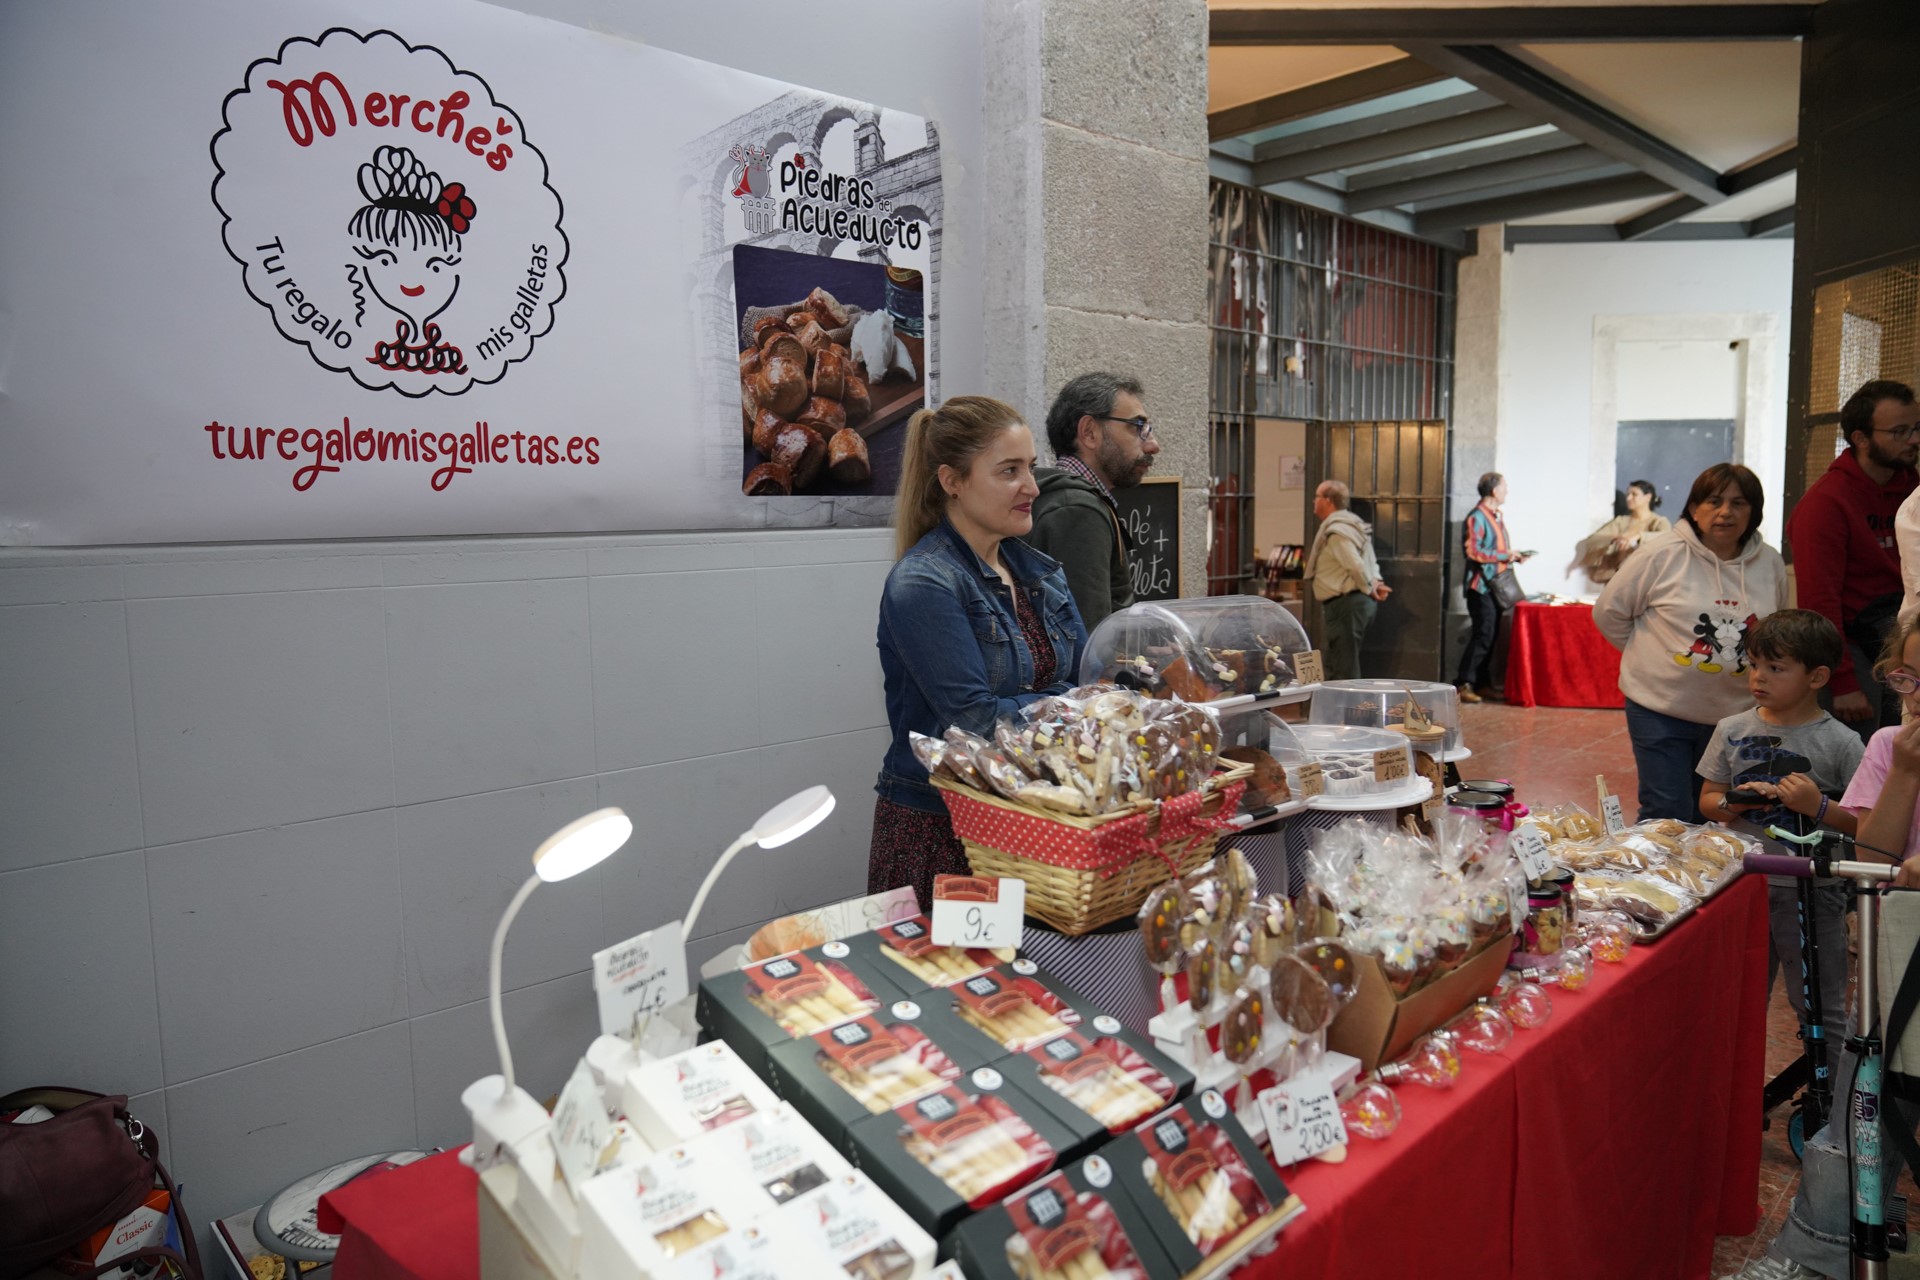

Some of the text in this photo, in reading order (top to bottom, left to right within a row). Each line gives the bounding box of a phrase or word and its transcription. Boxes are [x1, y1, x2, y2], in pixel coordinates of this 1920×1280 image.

[780, 155, 893, 213] Piedras del
[782, 198, 921, 250] Acueducto
[256, 235, 352, 349] Tu regalo
[475, 243, 548, 361] mis galletas
[204, 416, 600, 492] turegalomisgalletas.es
[115, 1219, 153, 1245] Classic
